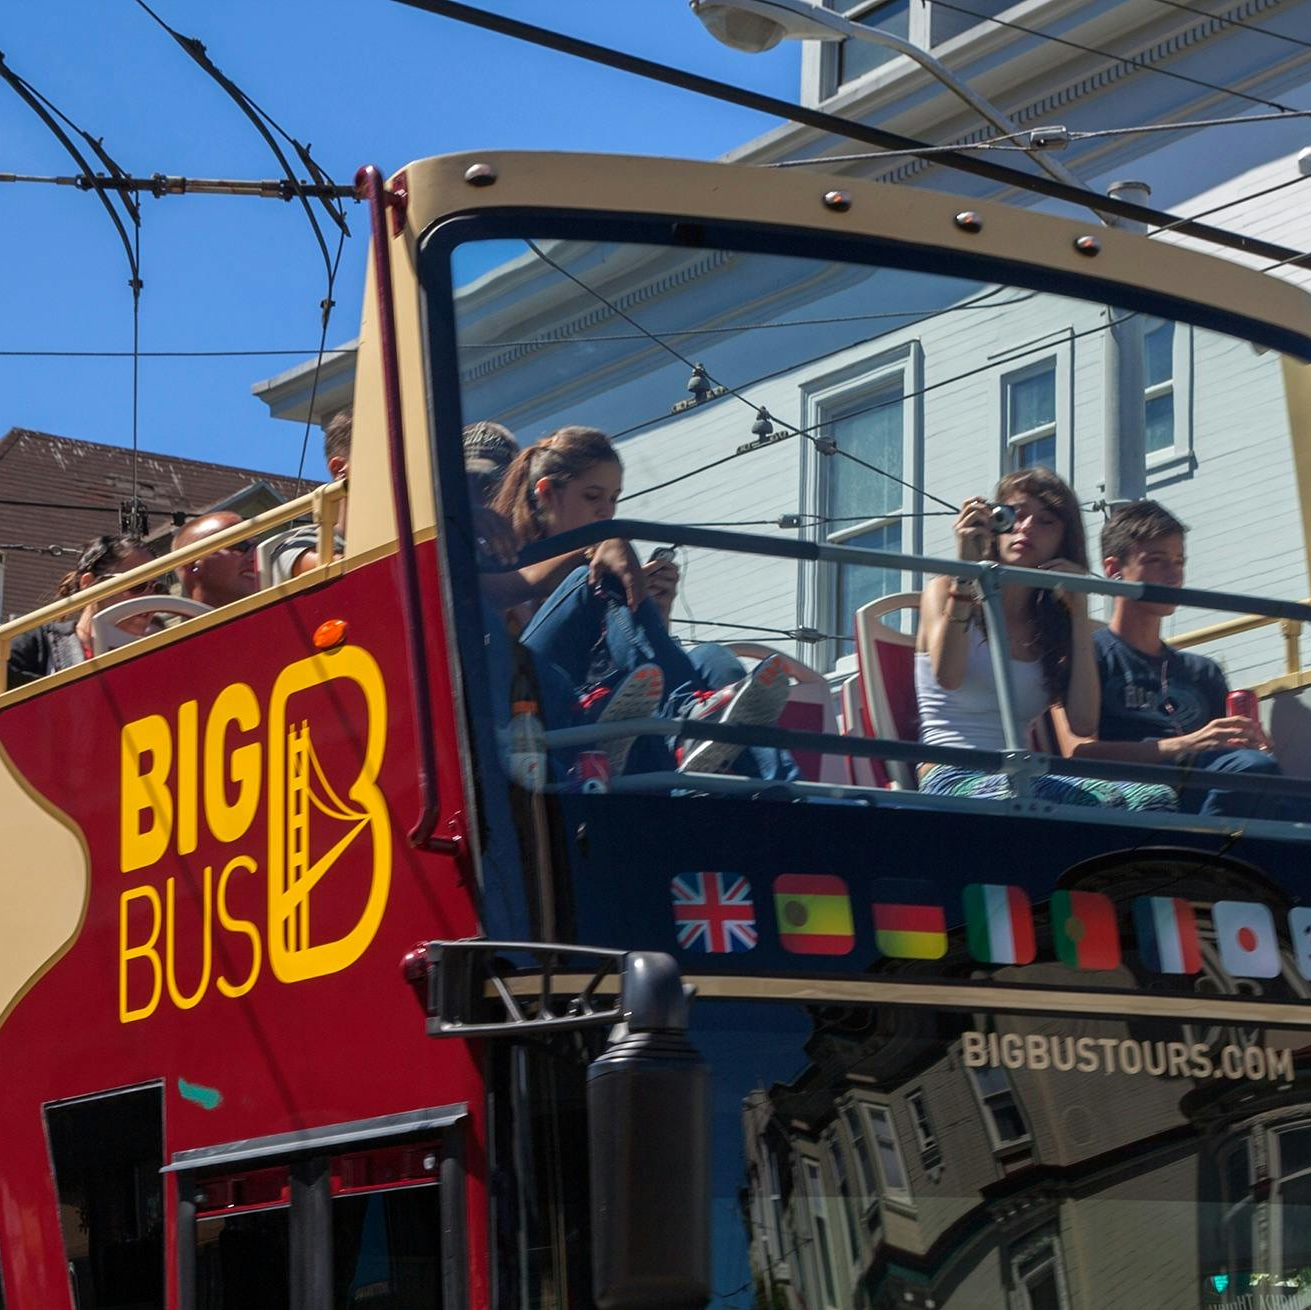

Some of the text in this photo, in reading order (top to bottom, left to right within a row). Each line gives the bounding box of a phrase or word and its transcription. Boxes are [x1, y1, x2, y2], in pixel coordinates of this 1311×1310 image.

[120, 682, 262, 873] BIG
[120, 855, 262, 1024] BUS
[961, 1031, 1296, 1083] BIGBUSTOURS.COM
